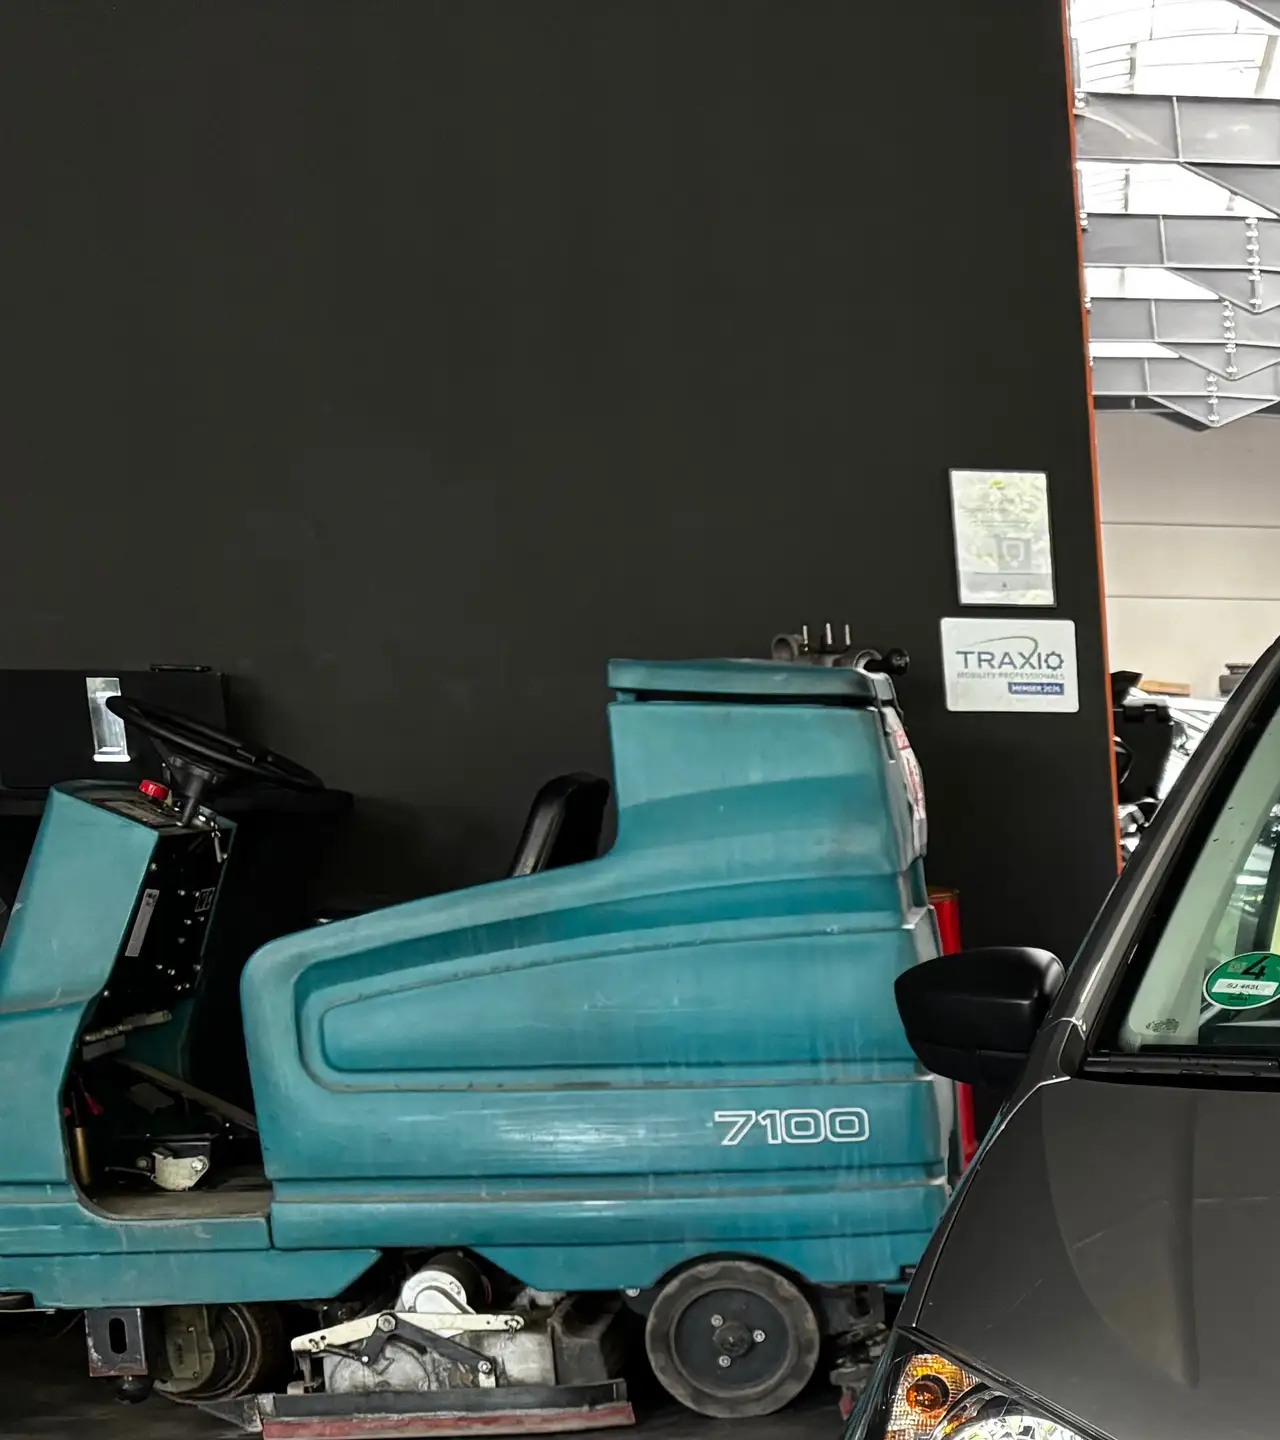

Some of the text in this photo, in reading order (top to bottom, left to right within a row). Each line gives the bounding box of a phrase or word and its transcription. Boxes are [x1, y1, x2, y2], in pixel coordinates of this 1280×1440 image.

[955, 650, 1065, 671] TRAXIO
[956, 671, 1066, 681] MOBILITY PROFESSIONALS
[1240, 955, 1271, 980] 4
[714, 1107, 870, 1146] 7100
